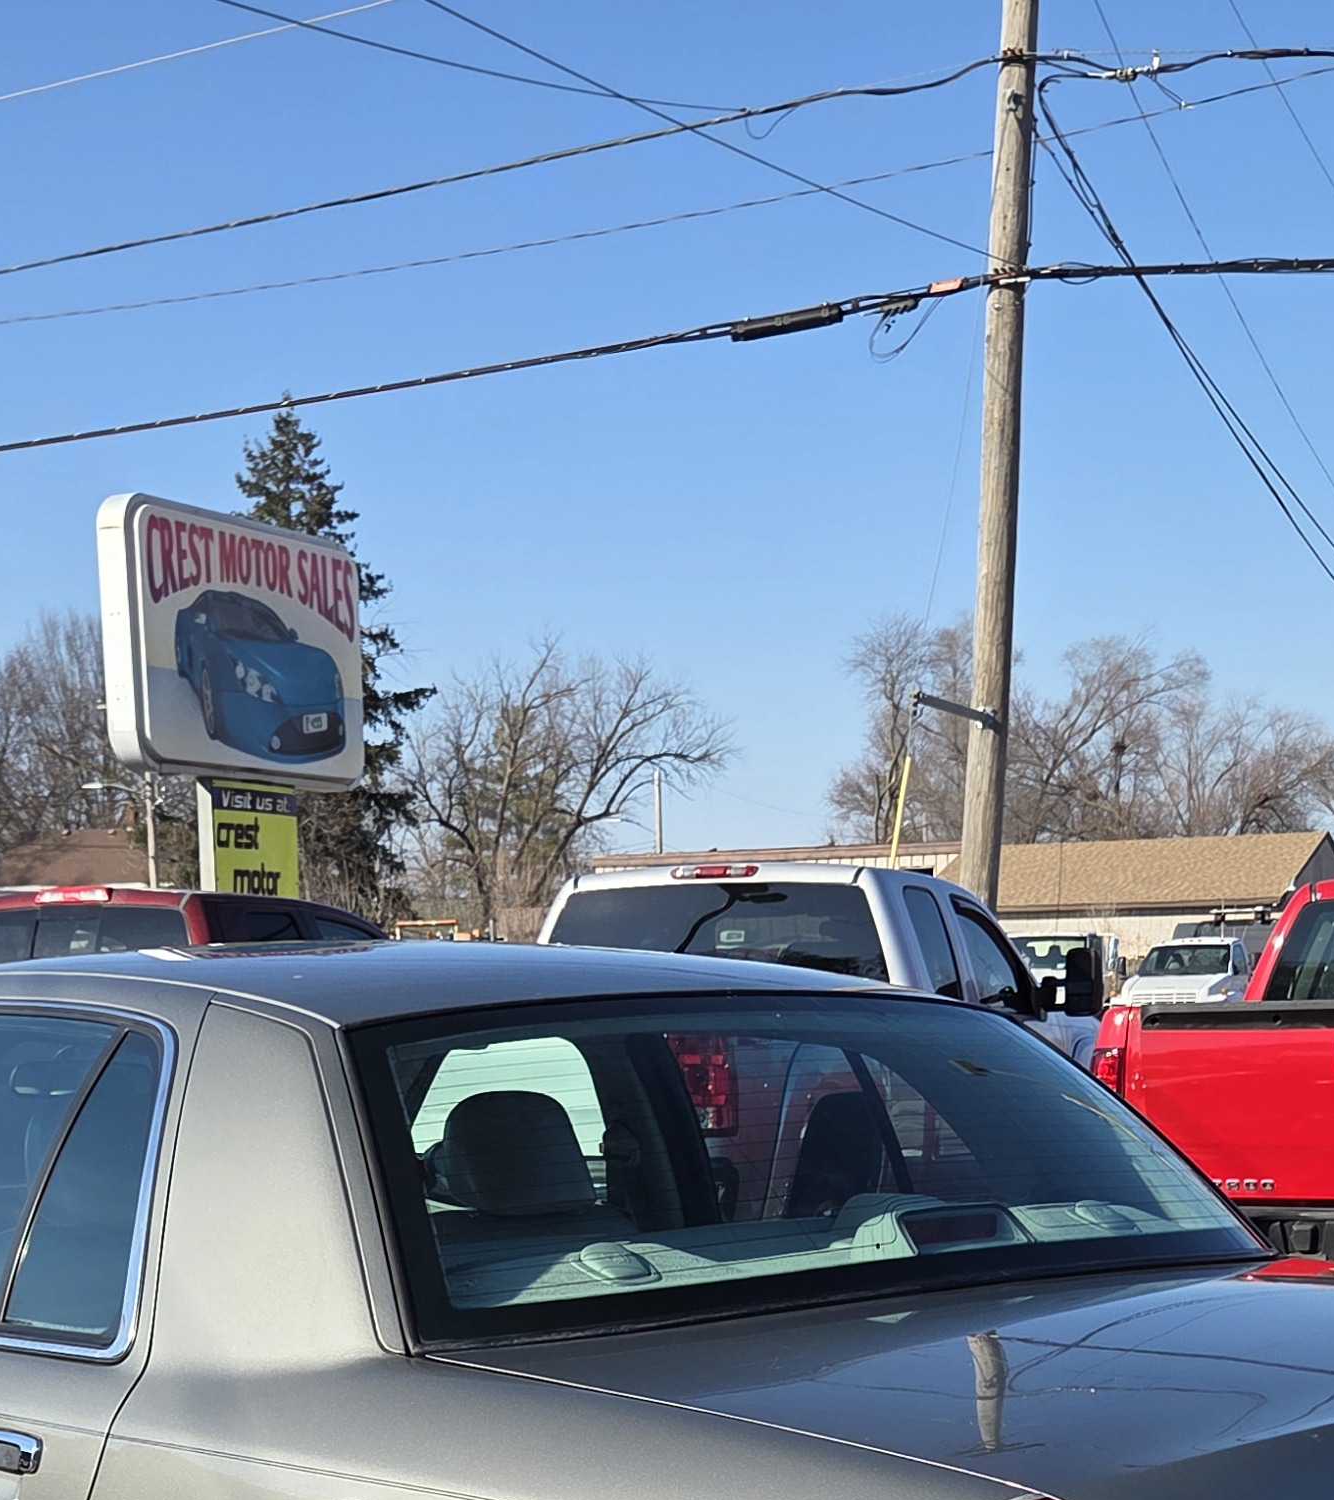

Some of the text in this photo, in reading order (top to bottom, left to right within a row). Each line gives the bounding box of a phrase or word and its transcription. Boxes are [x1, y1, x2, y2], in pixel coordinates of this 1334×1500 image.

[146, 514, 355, 643] CREST MOTOR SALES
[221, 790, 252, 810] Visit
[255, 796, 273, 811] us
[216, 815, 260, 851] crest
[233, 862, 282, 897] motor
